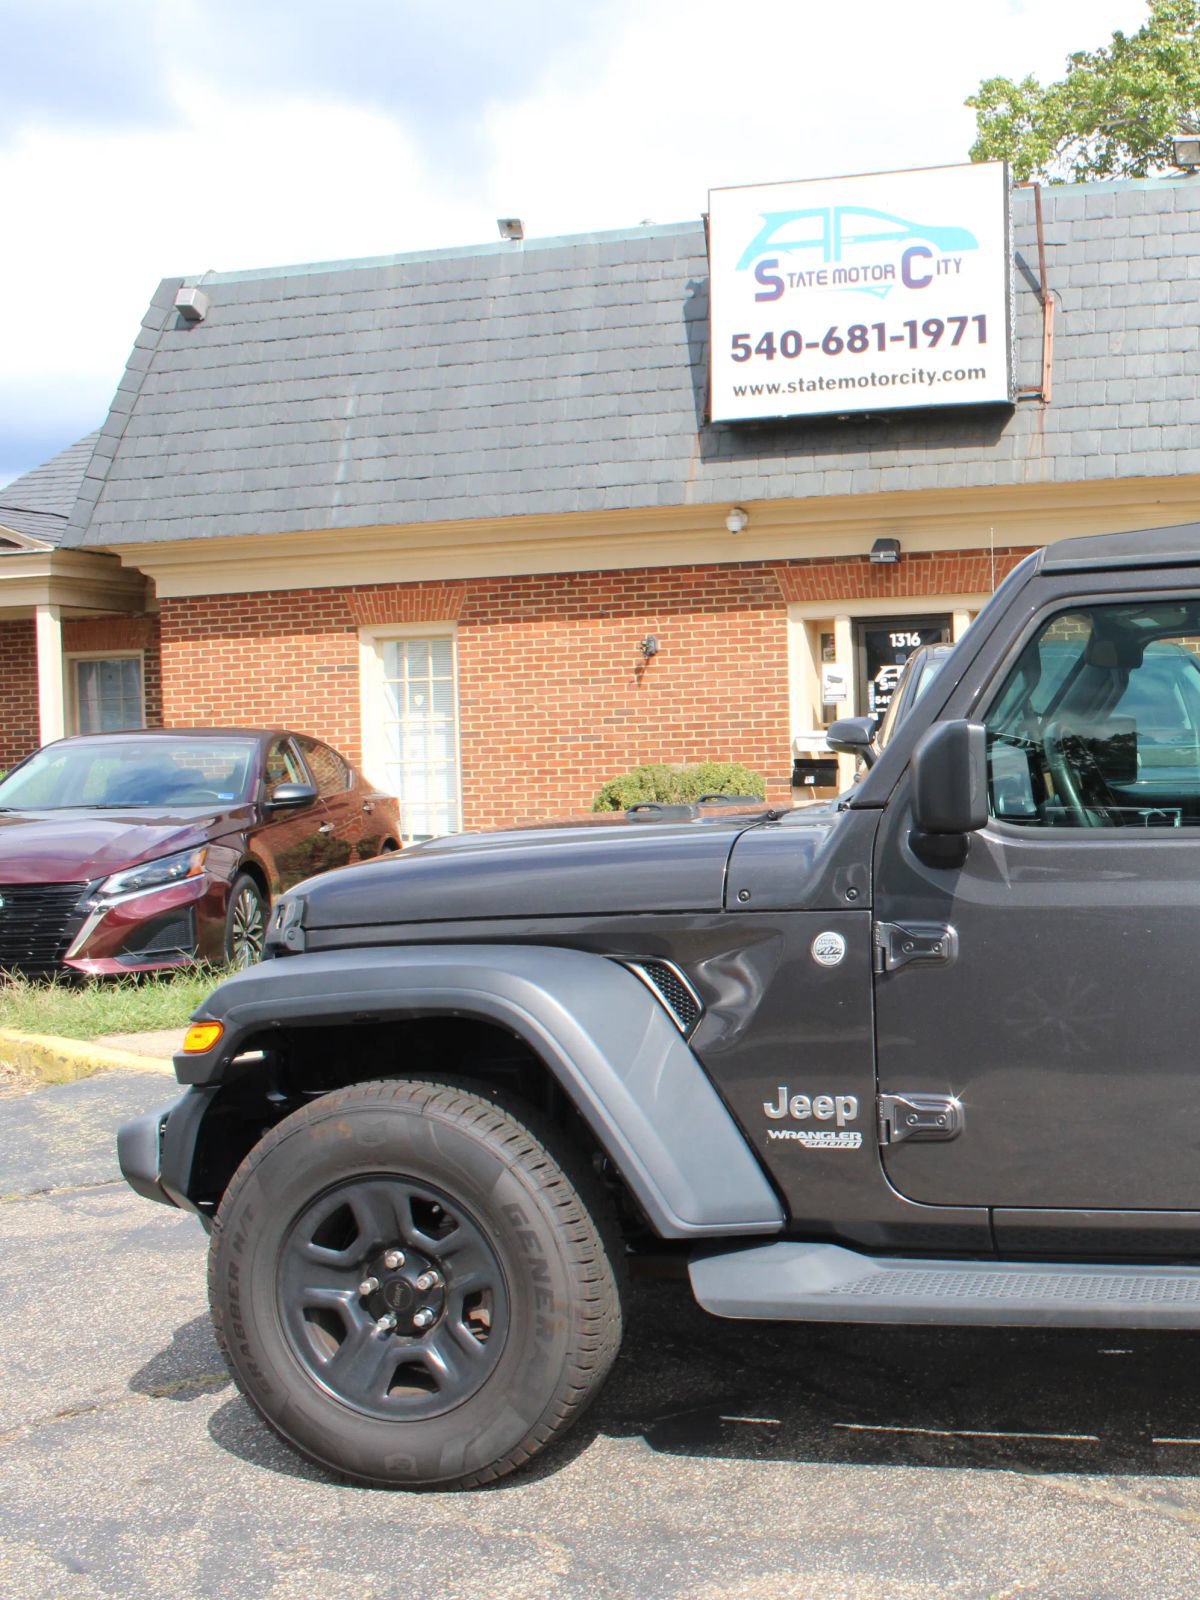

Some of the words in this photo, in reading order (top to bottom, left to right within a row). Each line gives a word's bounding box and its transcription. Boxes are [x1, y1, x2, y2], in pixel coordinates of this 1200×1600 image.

[754, 258, 828, 303] STATE
[832, 263, 896, 285] MOTOR
[901, 245, 963, 289] CITY
[730, 314, 988, 363] 540-681-1971
[732, 367, 987, 397] www.statemotorcity.com
[889, 632, 921, 648] 1316
[763, 1086, 859, 1127] Jeep
[766, 1129, 862, 1141] WRANGLER
[803, 1140, 861, 1148] SPORT
